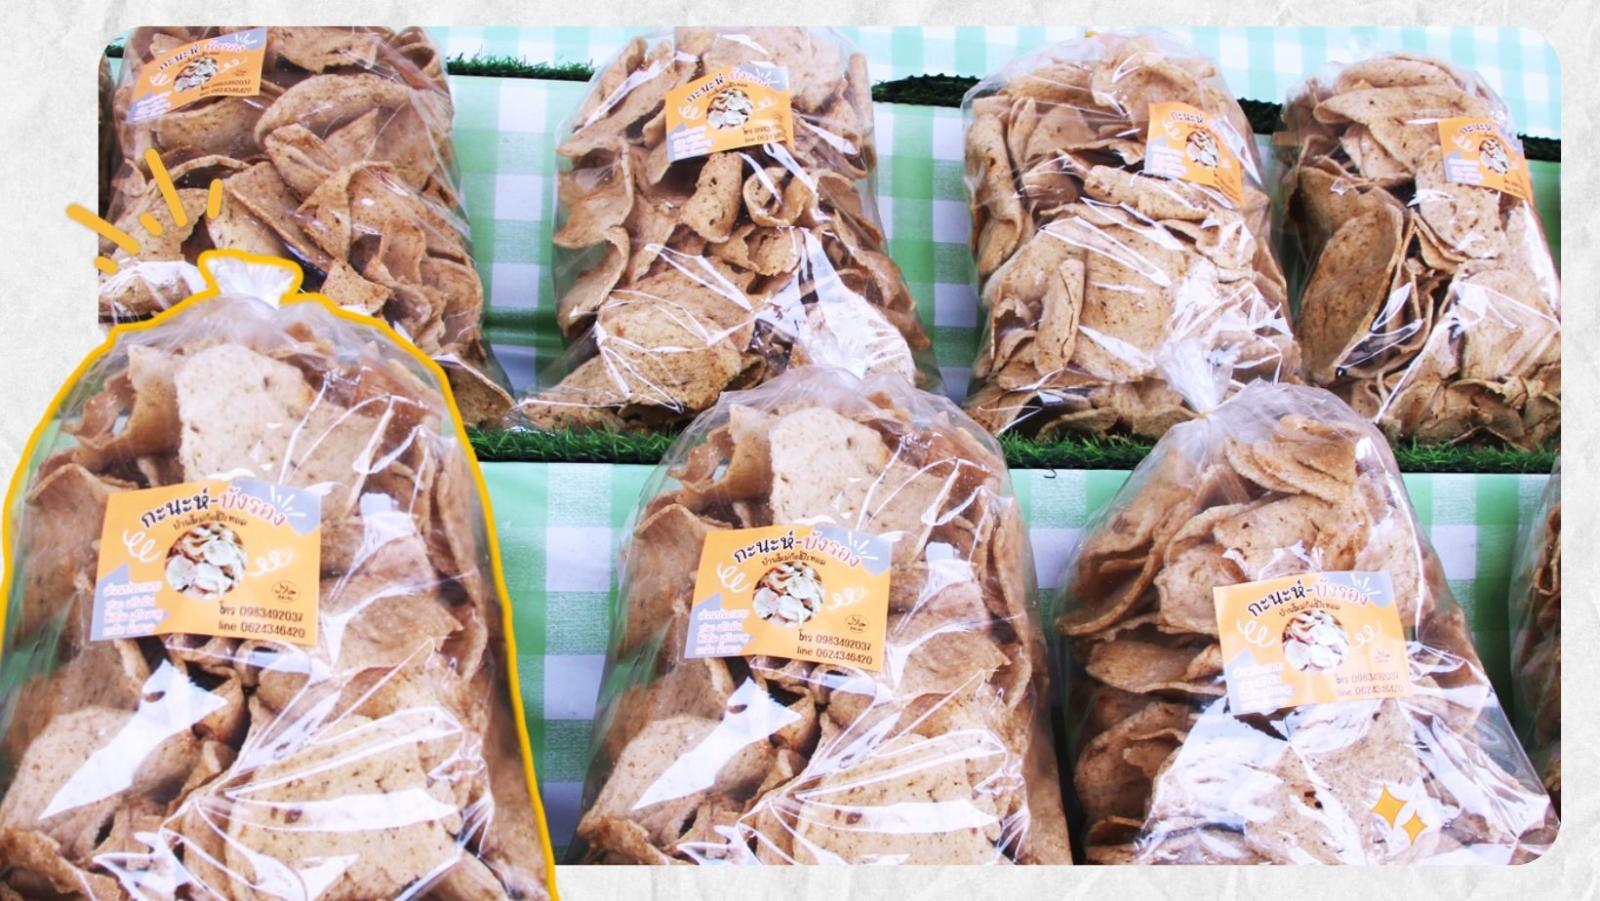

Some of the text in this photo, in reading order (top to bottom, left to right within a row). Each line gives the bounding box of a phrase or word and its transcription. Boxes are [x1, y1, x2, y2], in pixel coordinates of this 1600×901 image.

[218, 620, 306, 639] line 0624346420
[796, 646, 873, 665] line 0624346420
